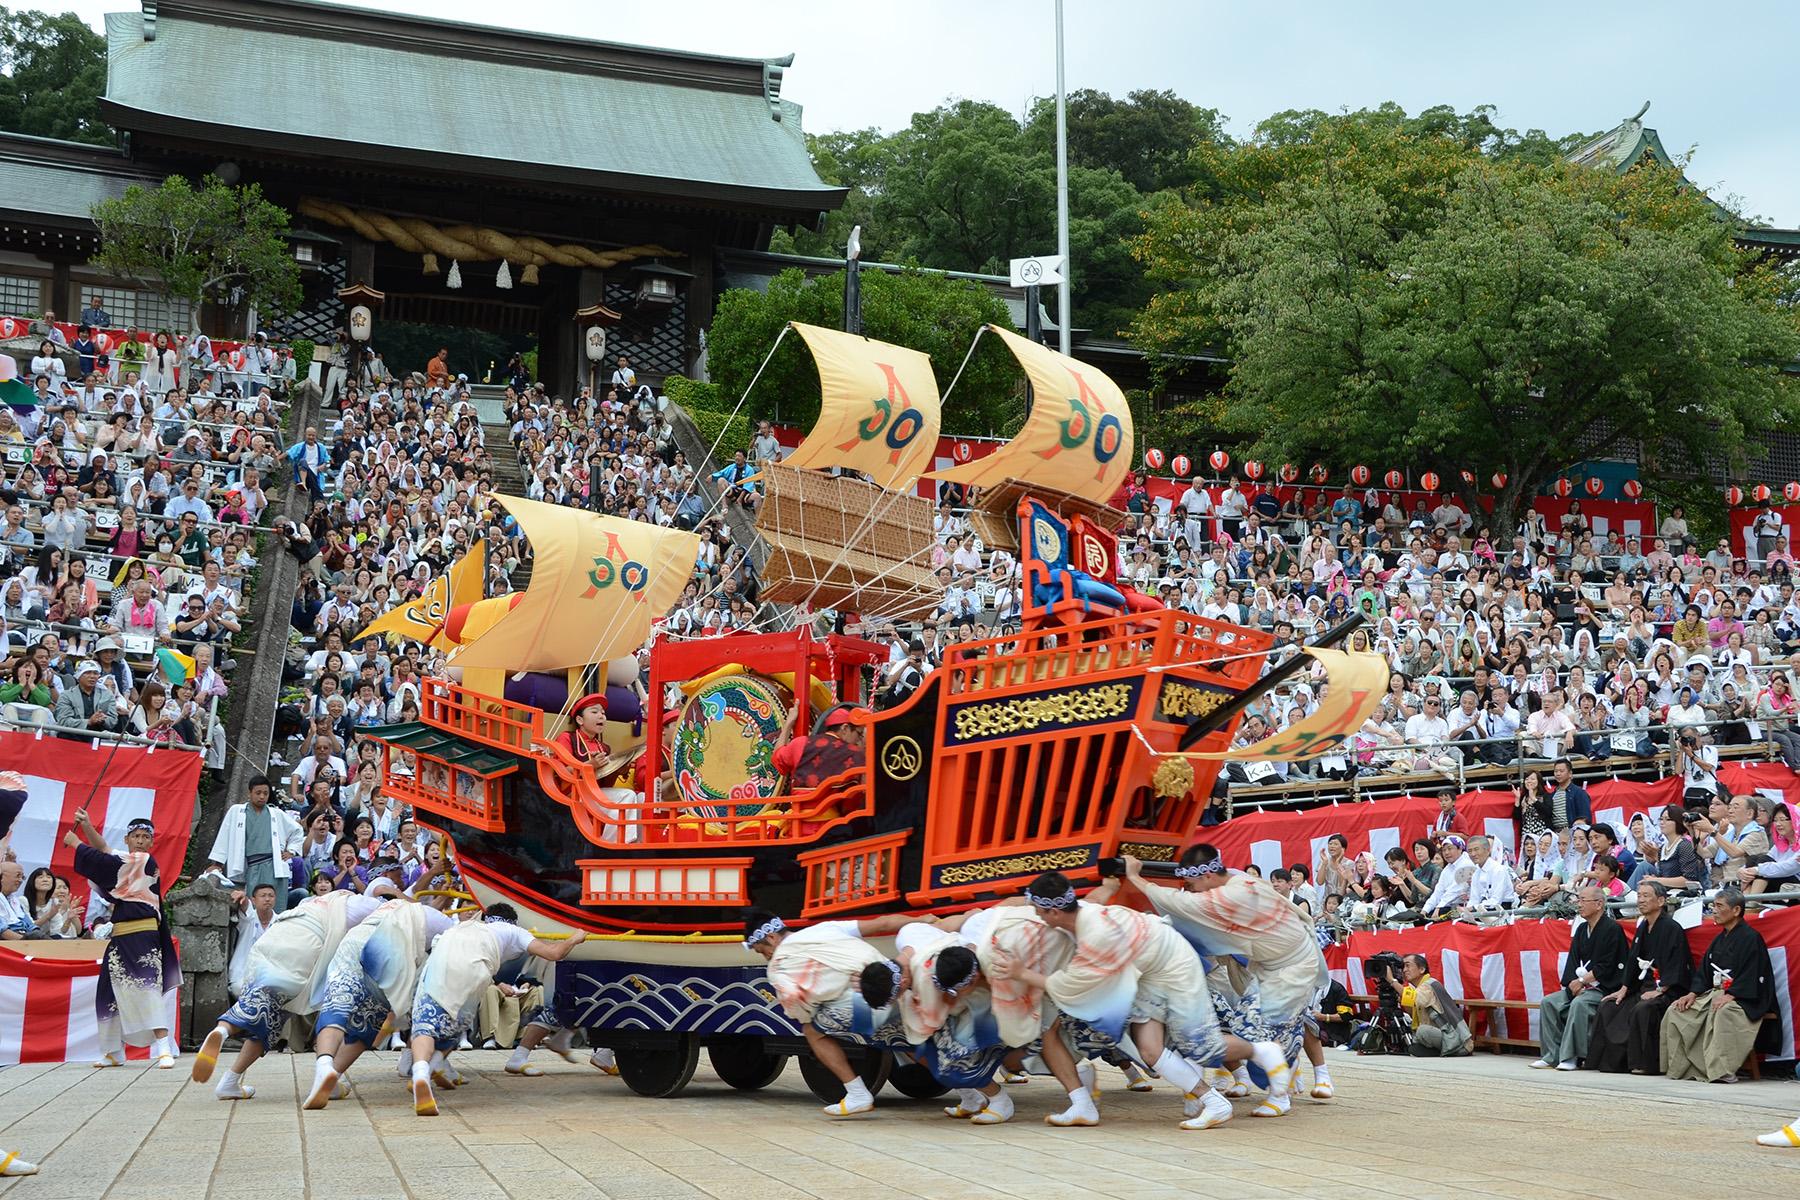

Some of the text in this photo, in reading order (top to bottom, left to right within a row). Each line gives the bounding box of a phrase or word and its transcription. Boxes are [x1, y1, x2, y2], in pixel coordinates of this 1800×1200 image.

[125, 638, 149, 651] L-1
[1612, 736, 1635, 750] K-8
[1247, 763, 1273, 779] K-4
